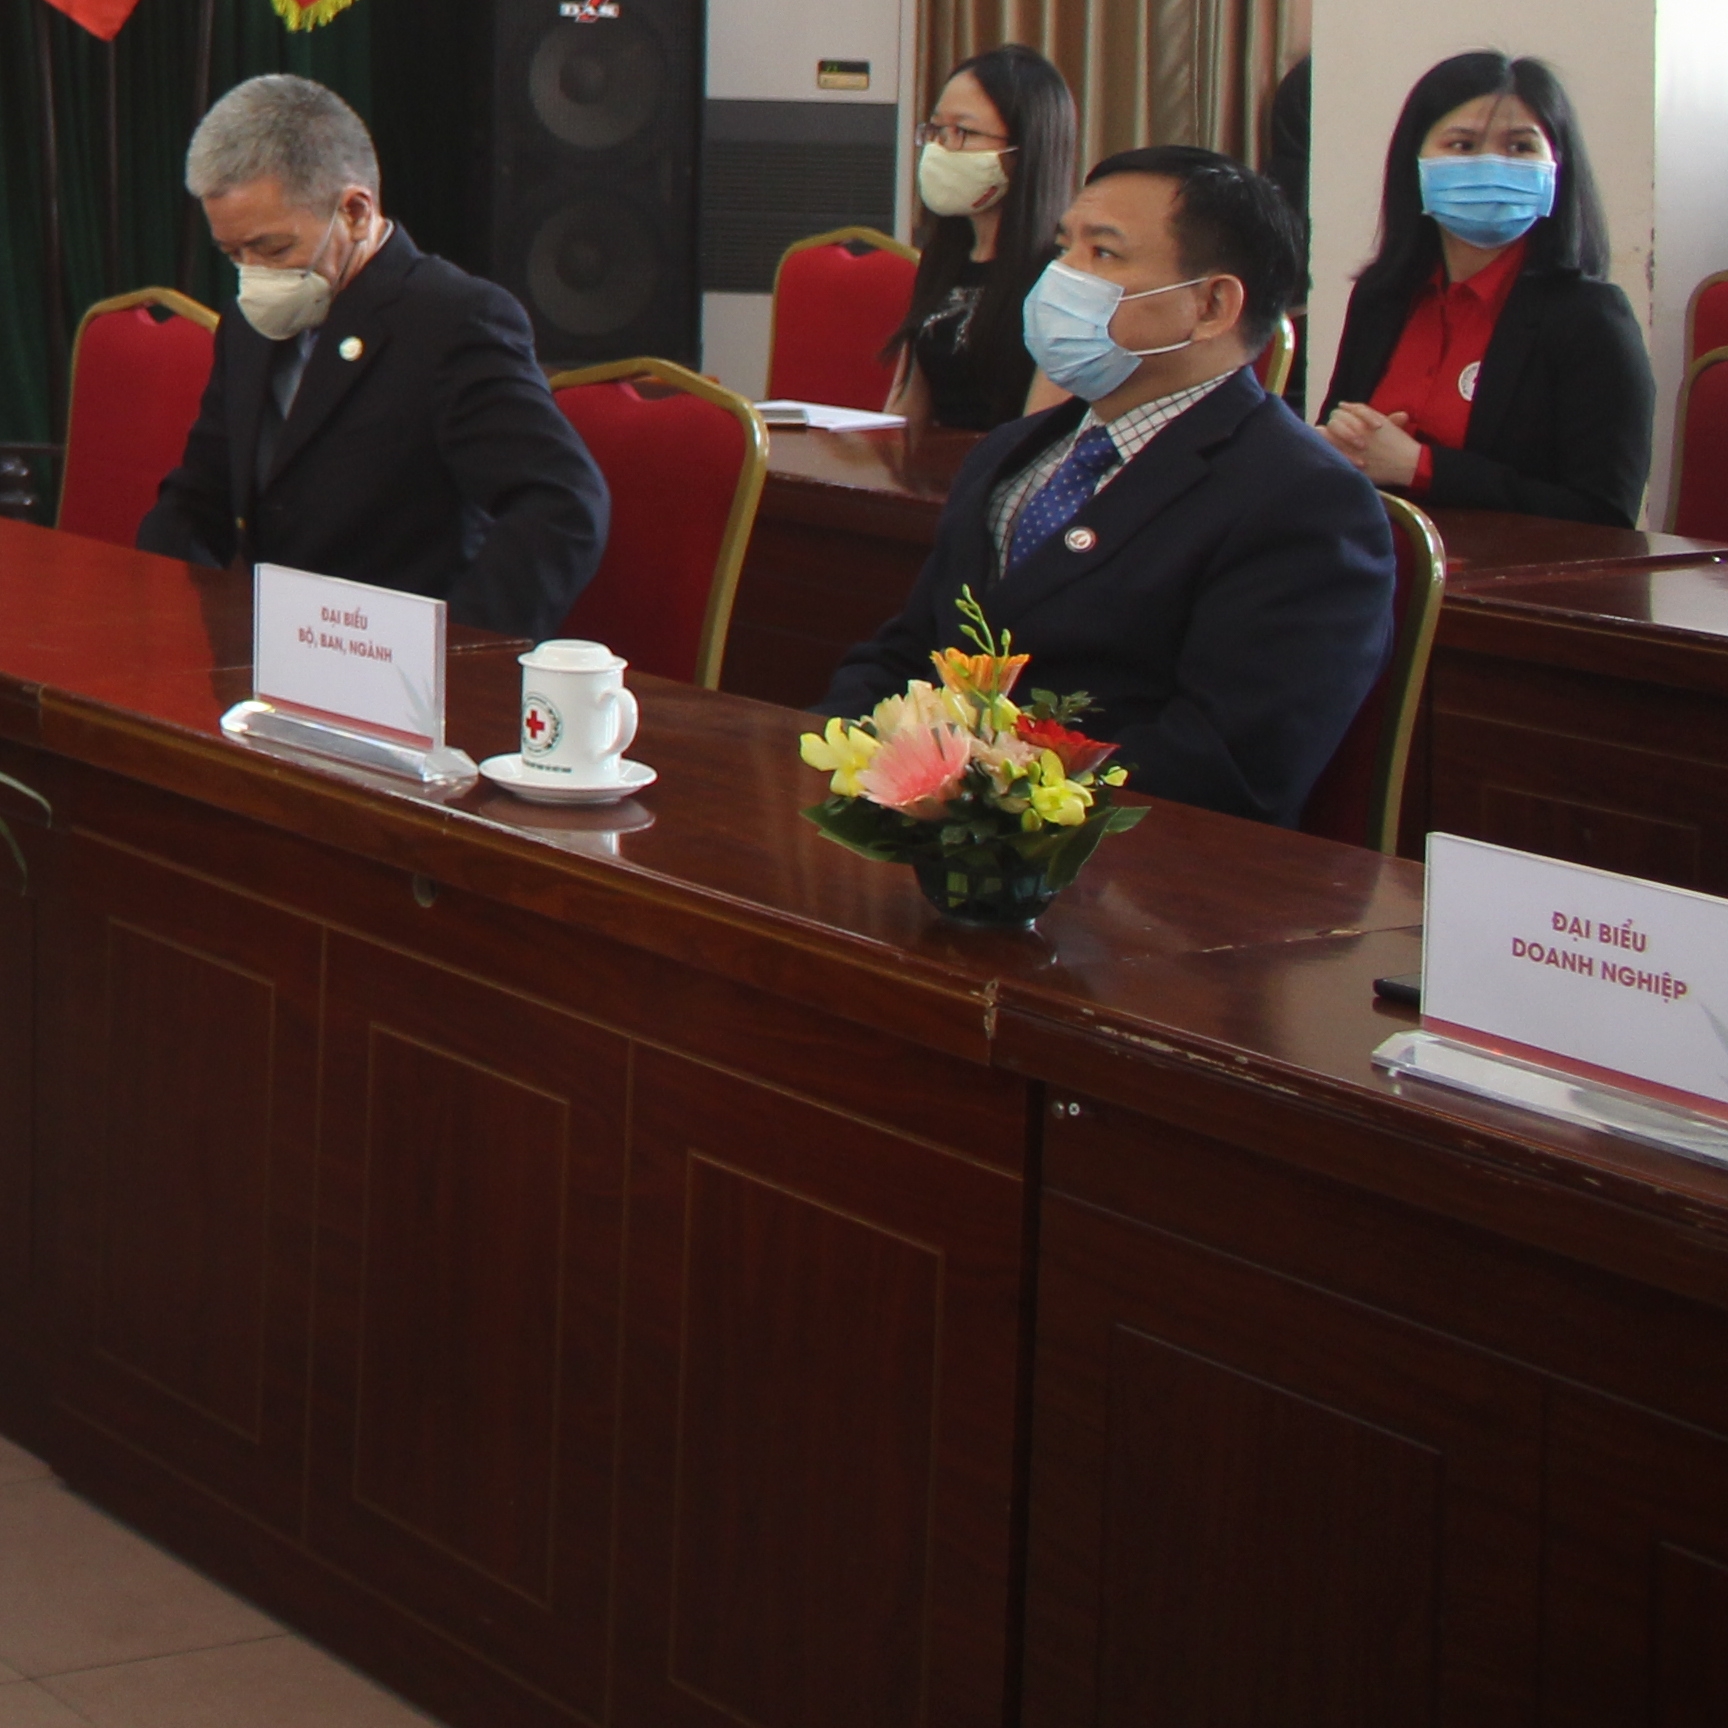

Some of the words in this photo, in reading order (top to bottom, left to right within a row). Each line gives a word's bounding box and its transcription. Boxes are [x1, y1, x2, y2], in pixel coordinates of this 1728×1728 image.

[321, 607, 341, 628] ĐẠI
[349, 639, 392, 663] NGÀNH
[1551, 911, 1591, 942] ĐẠI
[1598, 918, 1647, 953] BIỂU
[1511, 937, 1594, 977] DOANH
[1601, 961, 1688, 1003] NGHIỆP
